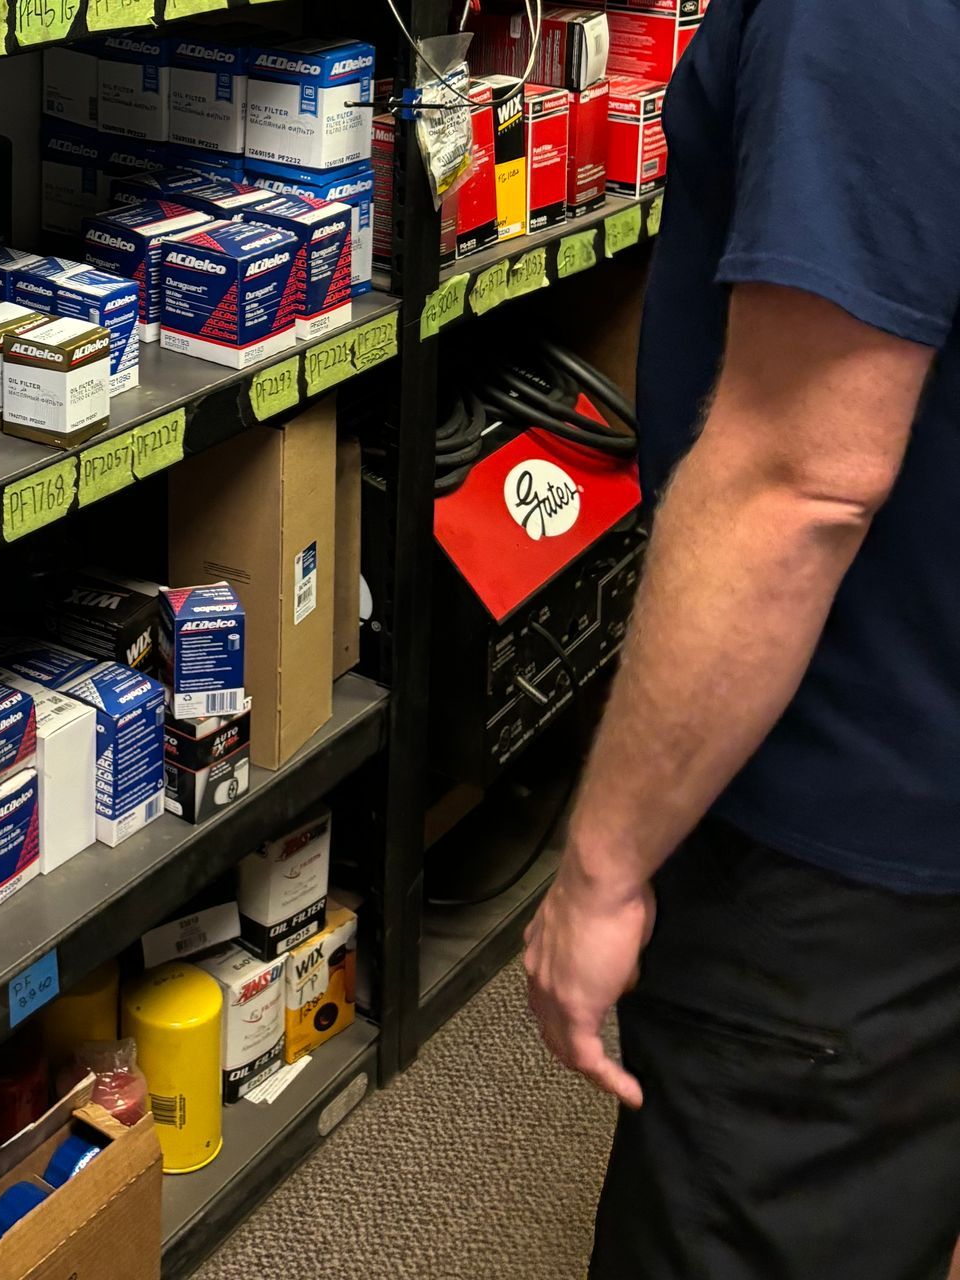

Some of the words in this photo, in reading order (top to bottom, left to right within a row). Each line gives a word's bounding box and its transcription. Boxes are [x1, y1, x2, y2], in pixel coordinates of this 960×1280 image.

[498, 94, 523, 124] WIX
[166, 252, 226, 274] ACDelco
[246, 252, 290, 276] ACDelco
[106, 311, 134, 326] Professional
[11, 343, 64, 362] ACDelco
[72, 337, 109, 360] ACDelco
[357, 323, 393, 357] PF2232
[310, 343, 347, 385] PF2221
[20, 380, 40, 390] FILTER
[255, 370, 291, 409] PF2193
[136, 421, 179, 464] PF2129
[84, 446, 130, 485] PF2057
[9, 474, 64, 530] PF1768
[515, 470, 579, 537] Gates
[181, 620, 236, 630] ACDelco
[127, 626, 152, 661] WIX
[214, 726, 239, 746] AUTO
[269, 918, 289, 938] OIL
[292, 900, 325, 926] FILTER
[295, 943, 324, 979] WIX
[229, 1061, 249, 1082] OIL
